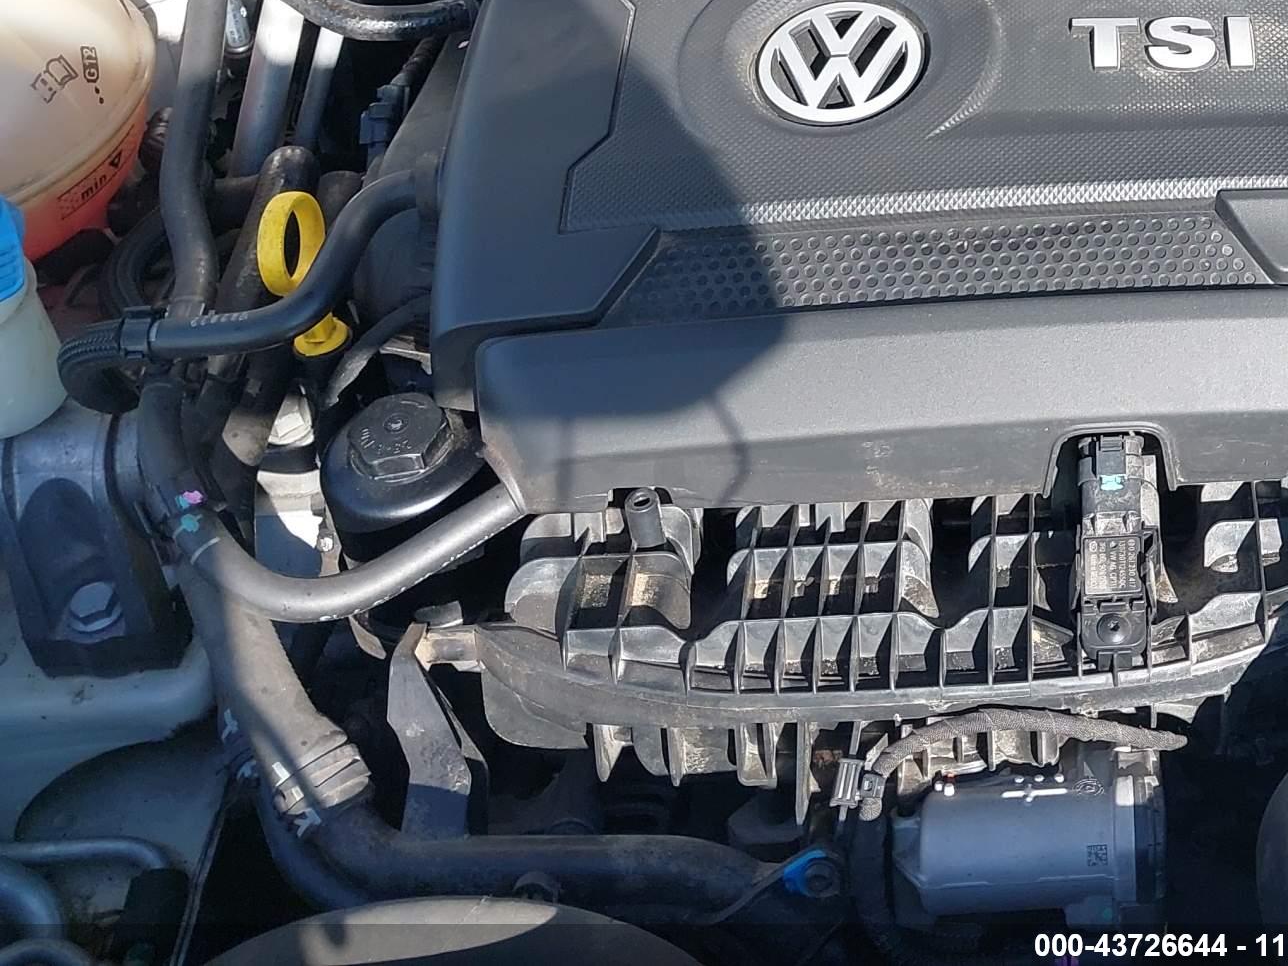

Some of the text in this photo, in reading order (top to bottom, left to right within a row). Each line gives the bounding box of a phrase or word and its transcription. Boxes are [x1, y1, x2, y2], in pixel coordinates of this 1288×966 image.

[1070, 15, 1256, 71] TSI
[82, 47, 98, 81] G12
[80, 172, 108, 201] min
